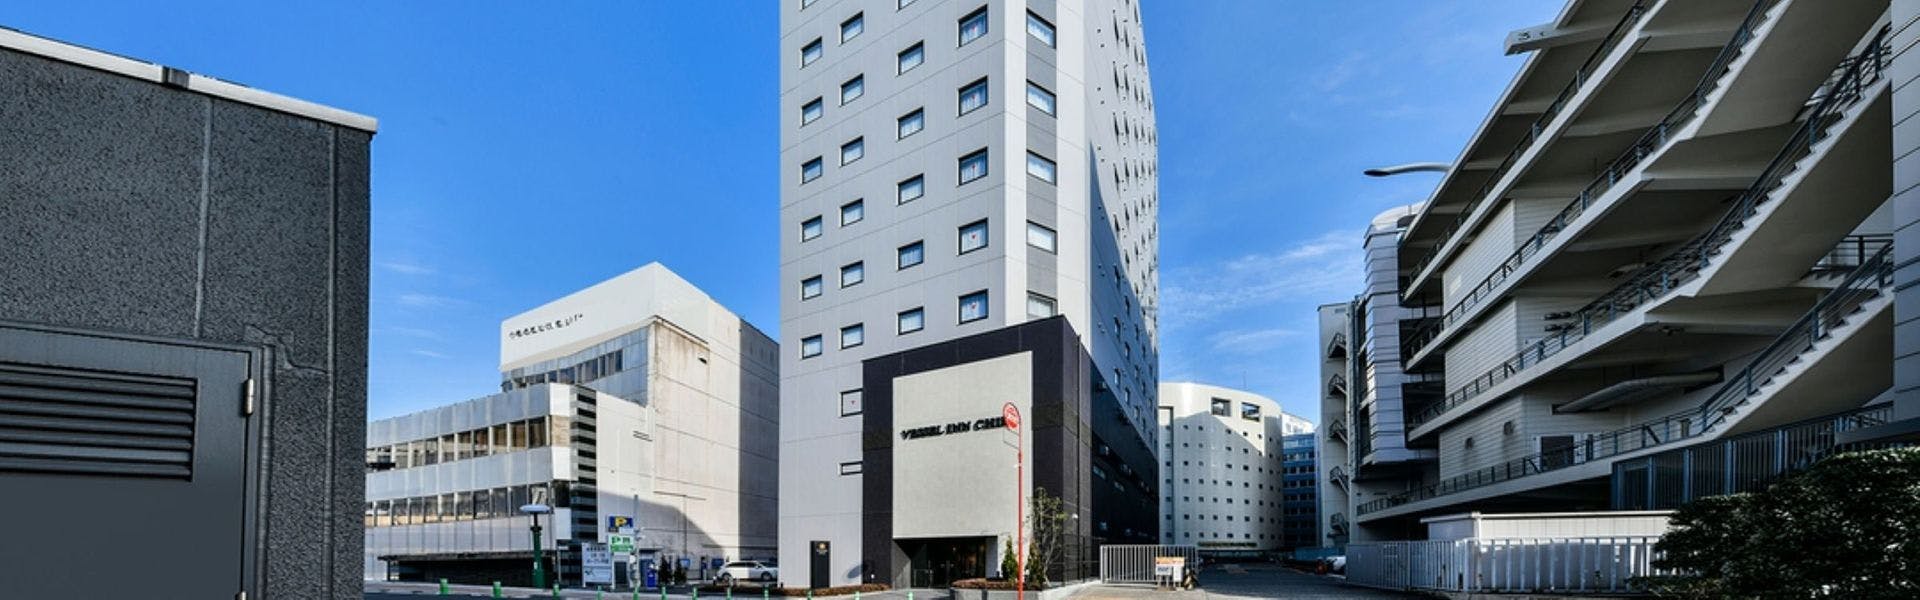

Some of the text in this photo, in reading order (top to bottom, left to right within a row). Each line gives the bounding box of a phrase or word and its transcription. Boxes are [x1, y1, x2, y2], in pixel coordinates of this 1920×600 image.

[900, 425, 945, 440] VESSEL
[945, 420, 971, 434] INN
[614, 516, 627, 527] P
